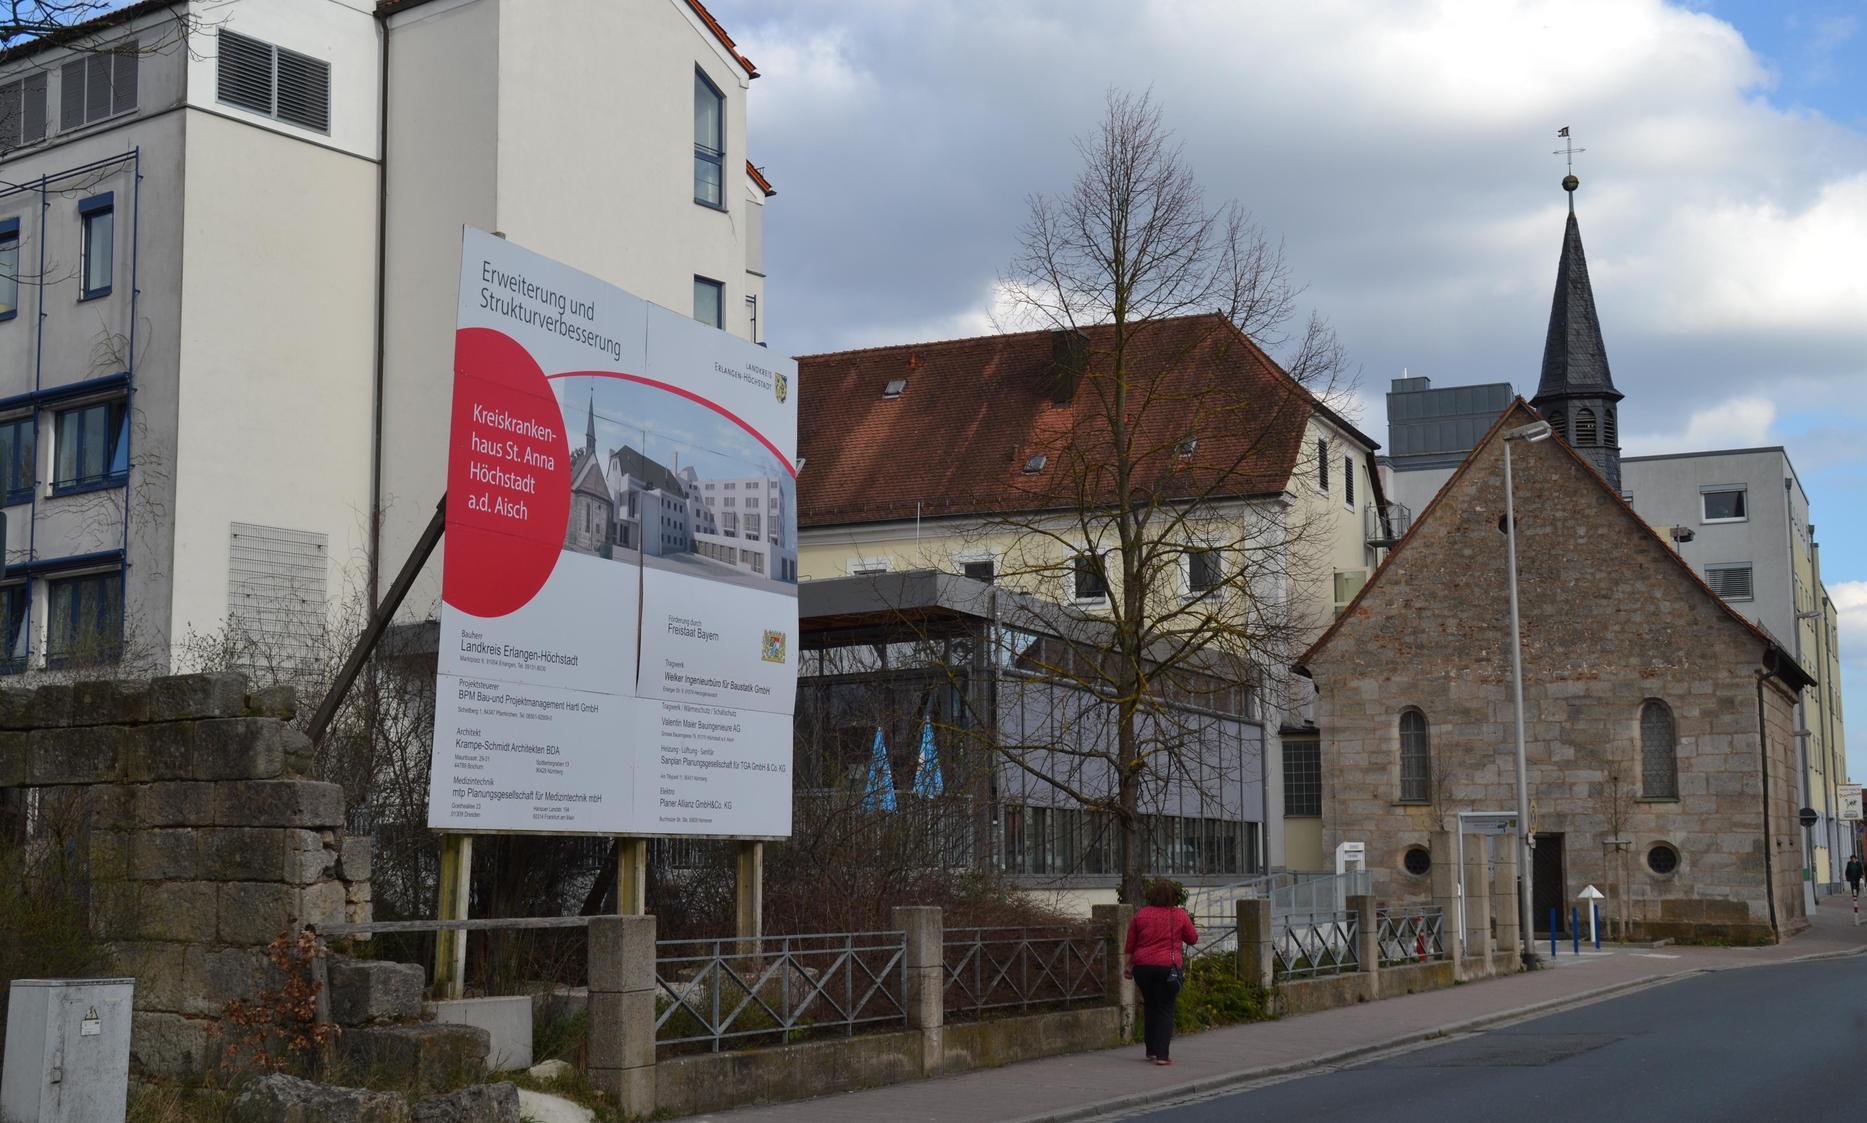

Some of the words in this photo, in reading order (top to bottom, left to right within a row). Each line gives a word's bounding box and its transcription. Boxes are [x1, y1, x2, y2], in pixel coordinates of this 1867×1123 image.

[482, 260, 566, 316] Erweiterung
[571, 299, 594, 322] und
[480, 288, 622, 362] Strukturverbesserung
[746, 363, 772, 379] LANDKREIS
[473, 404, 557, 443] Kreiskranken-
[472, 432, 502, 457] haus
[506, 440, 522, 462] St.
[523, 447, 555, 471] Anna
[470, 461, 536, 494] Höchstadt
[468, 493, 492, 511] a.d.
[494, 498, 528, 520] Aisch
[461, 629, 483, 639] Bauherr
[668, 623, 696, 637] Freistaat
[697, 628, 719, 642] Bayern
[460, 639, 501, 656] Landkreis
[503, 645, 578, 666] Erlangen-Höchstadt
[459, 679, 500, 690] Projektsteuerer
[665, 672, 684, 682] Welker
[685, 674, 721, 688] Ingenieurbüro
[730, 681, 753, 692] Baustatik
[754, 684, 770, 695] GmbH
[459, 689, 475, 700] BPM
[477, 691, 504, 704] Bau-und
[505, 695, 565, 710] Projektmanagement
[580, 704, 599, 713] GmbH
[456, 728, 481, 737] Architekt
[662, 716, 681, 727] Valentin
[733, 724, 740, 732] AG
[456, 738, 510, 753] Krampe-Schmidt
[511, 743, 545, 754] Architekten
[546, 746, 560, 755] BDA
[683, 757, 732, 770] Planungsgesellschaft
[752, 762, 766, 771] GmbH
[779, 764, 786, 773] KG
[453, 776, 494, 786] Medizintechnik
[453, 788, 465, 799] mtp
[467, 788, 534, 800] Planungsgesellschaft
[535, 791, 544, 800] für
[545, 792, 587, 802] Medizintechnik
[660, 799, 677, 807] Planer
[678, 800, 694, 808] Allianz
